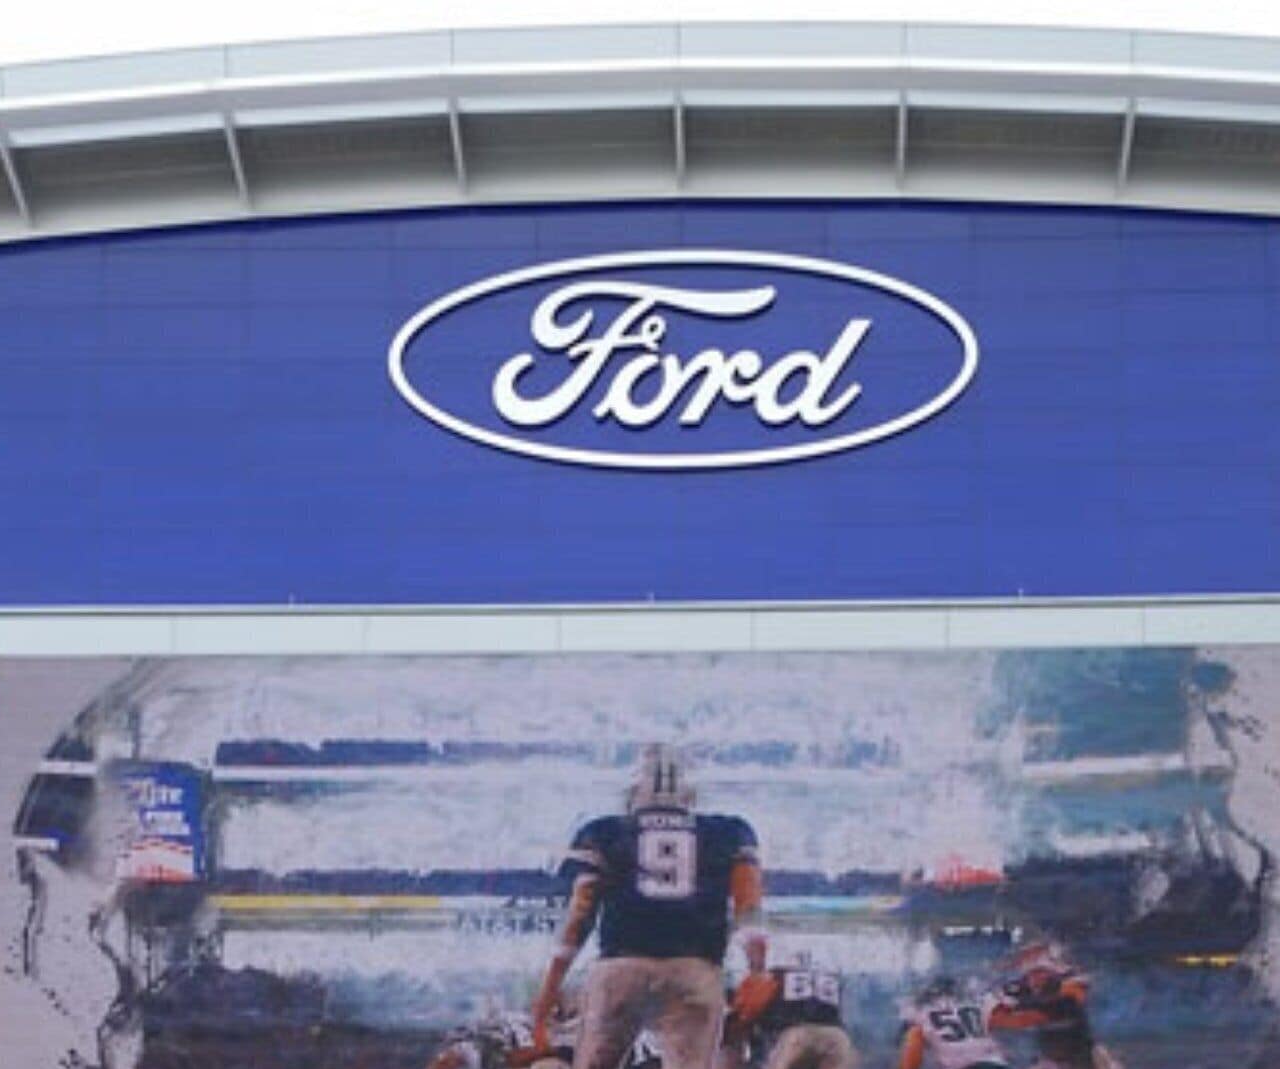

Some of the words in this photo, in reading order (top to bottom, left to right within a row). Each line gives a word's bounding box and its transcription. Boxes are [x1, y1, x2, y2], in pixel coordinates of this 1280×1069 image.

[492, 280, 872, 425] Ford
[637, 831, 697, 896] 9
[929, 1005, 983, 1042] 50
